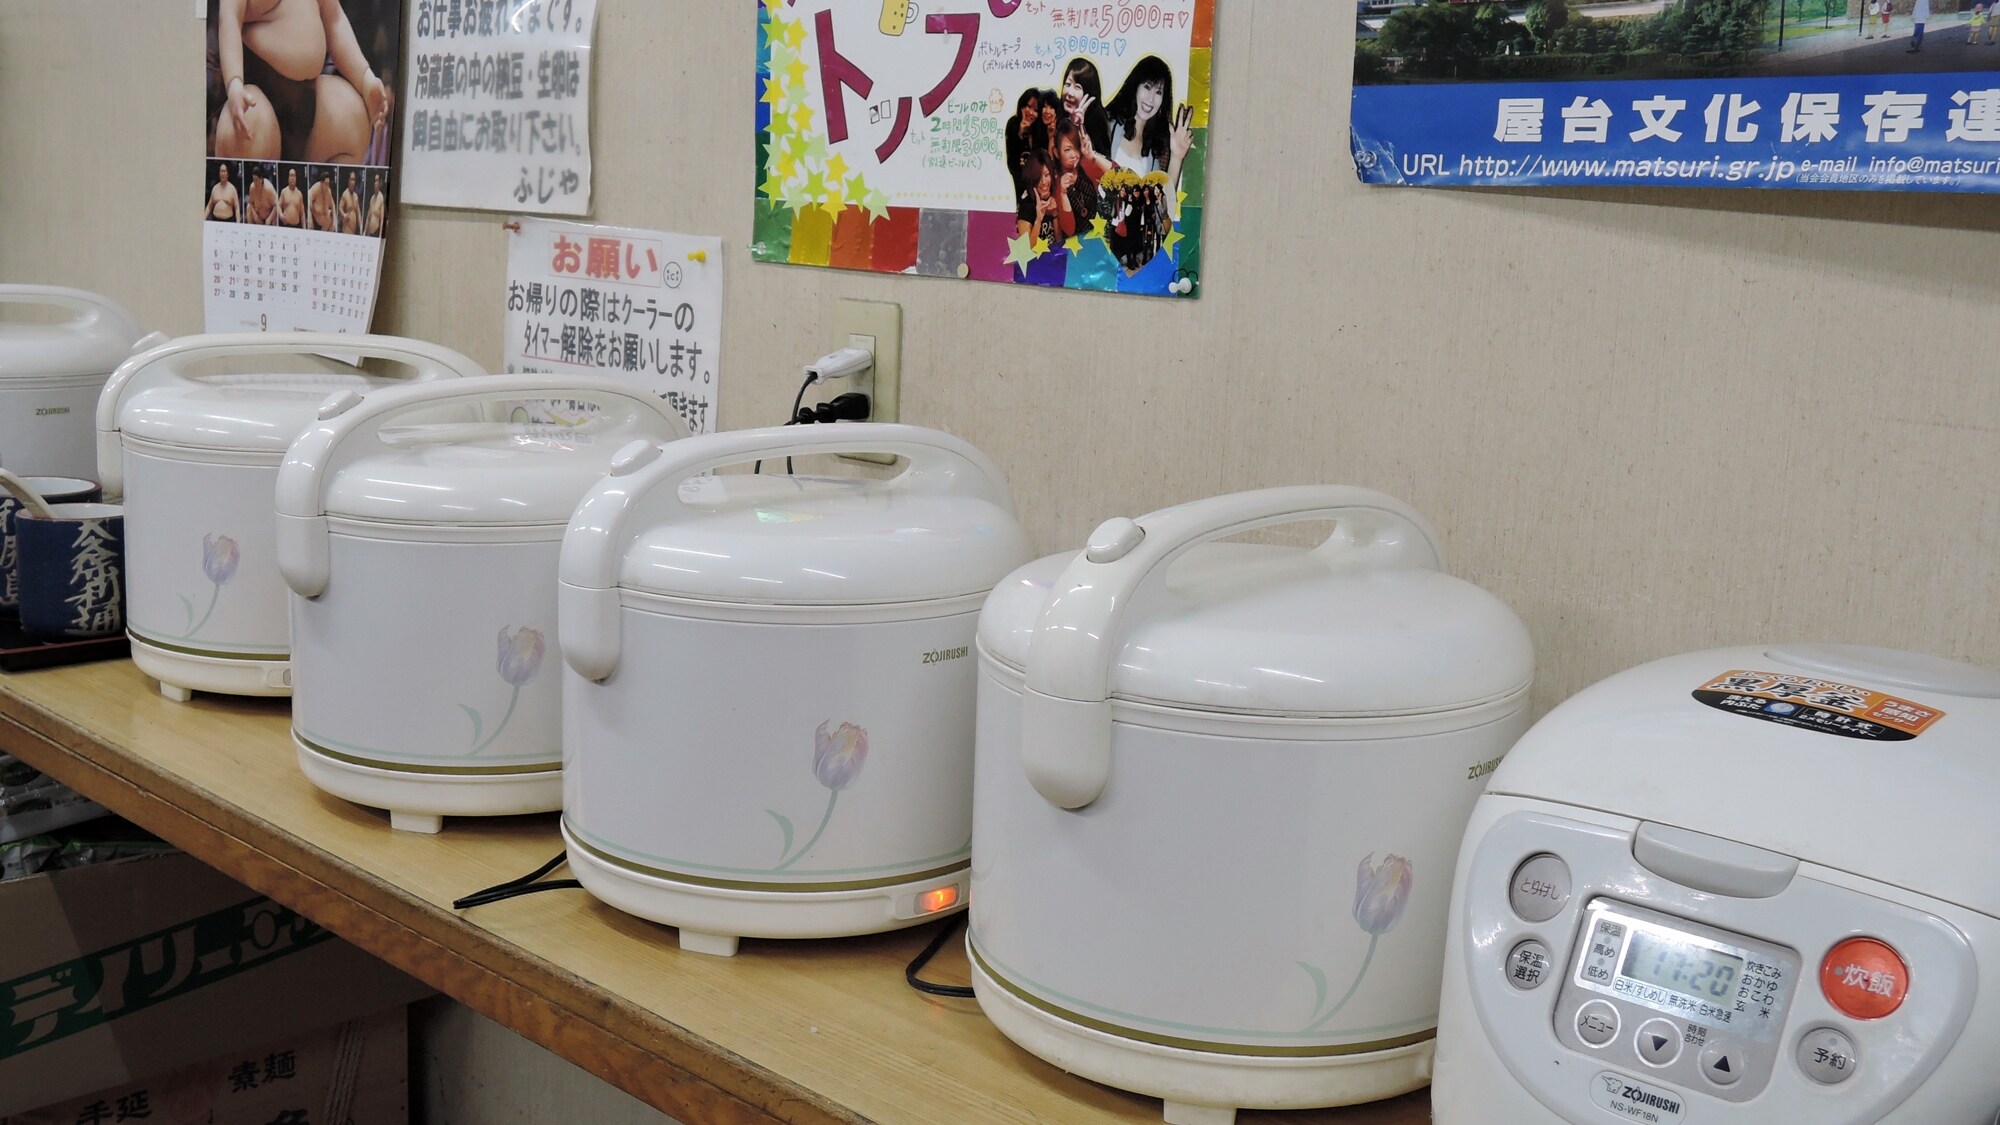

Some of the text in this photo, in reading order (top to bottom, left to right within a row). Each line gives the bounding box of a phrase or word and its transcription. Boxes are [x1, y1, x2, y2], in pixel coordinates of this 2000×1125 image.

[1403, 153, 1450, 176] URL
[1459, 154, 1795, 182] http://www.matsuri.gr.jp
[1801, 156, 1858, 172] e-mail
[514, 166, 580, 204] ふじや
[552, 235, 658, 280] お願い
[508, 280, 694, 332] お帰りの際はクーラーの
[260, 313, 267, 332] 9
[524, 320, 710, 384] タイマー解除をお願いします。
[922, 646, 968, 666] ZOJIRUSHI
[1520, 878, 1559, 900] とりけし
[1519, 950, 1544, 969] 保温
[1593, 943, 1615, 958] 高め
[1514, 965, 1540, 984] 選択
[1587, 966, 1609, 981] 低め
[1745, 961, 1782, 980] 炊きこみ
[1842, 963, 1896, 998] 炊飯
[1742, 974, 1778, 992] おかゆ
[1738, 988, 1774, 1006] おこわ
[1581, 1015, 1614, 1033] メニュー
[1814, 1047, 1847, 1070] 予約
[1622, 1086, 1681, 1115] ZOJIRUSHI
[1609, 1100, 1659, 1123] NS-WF18N
